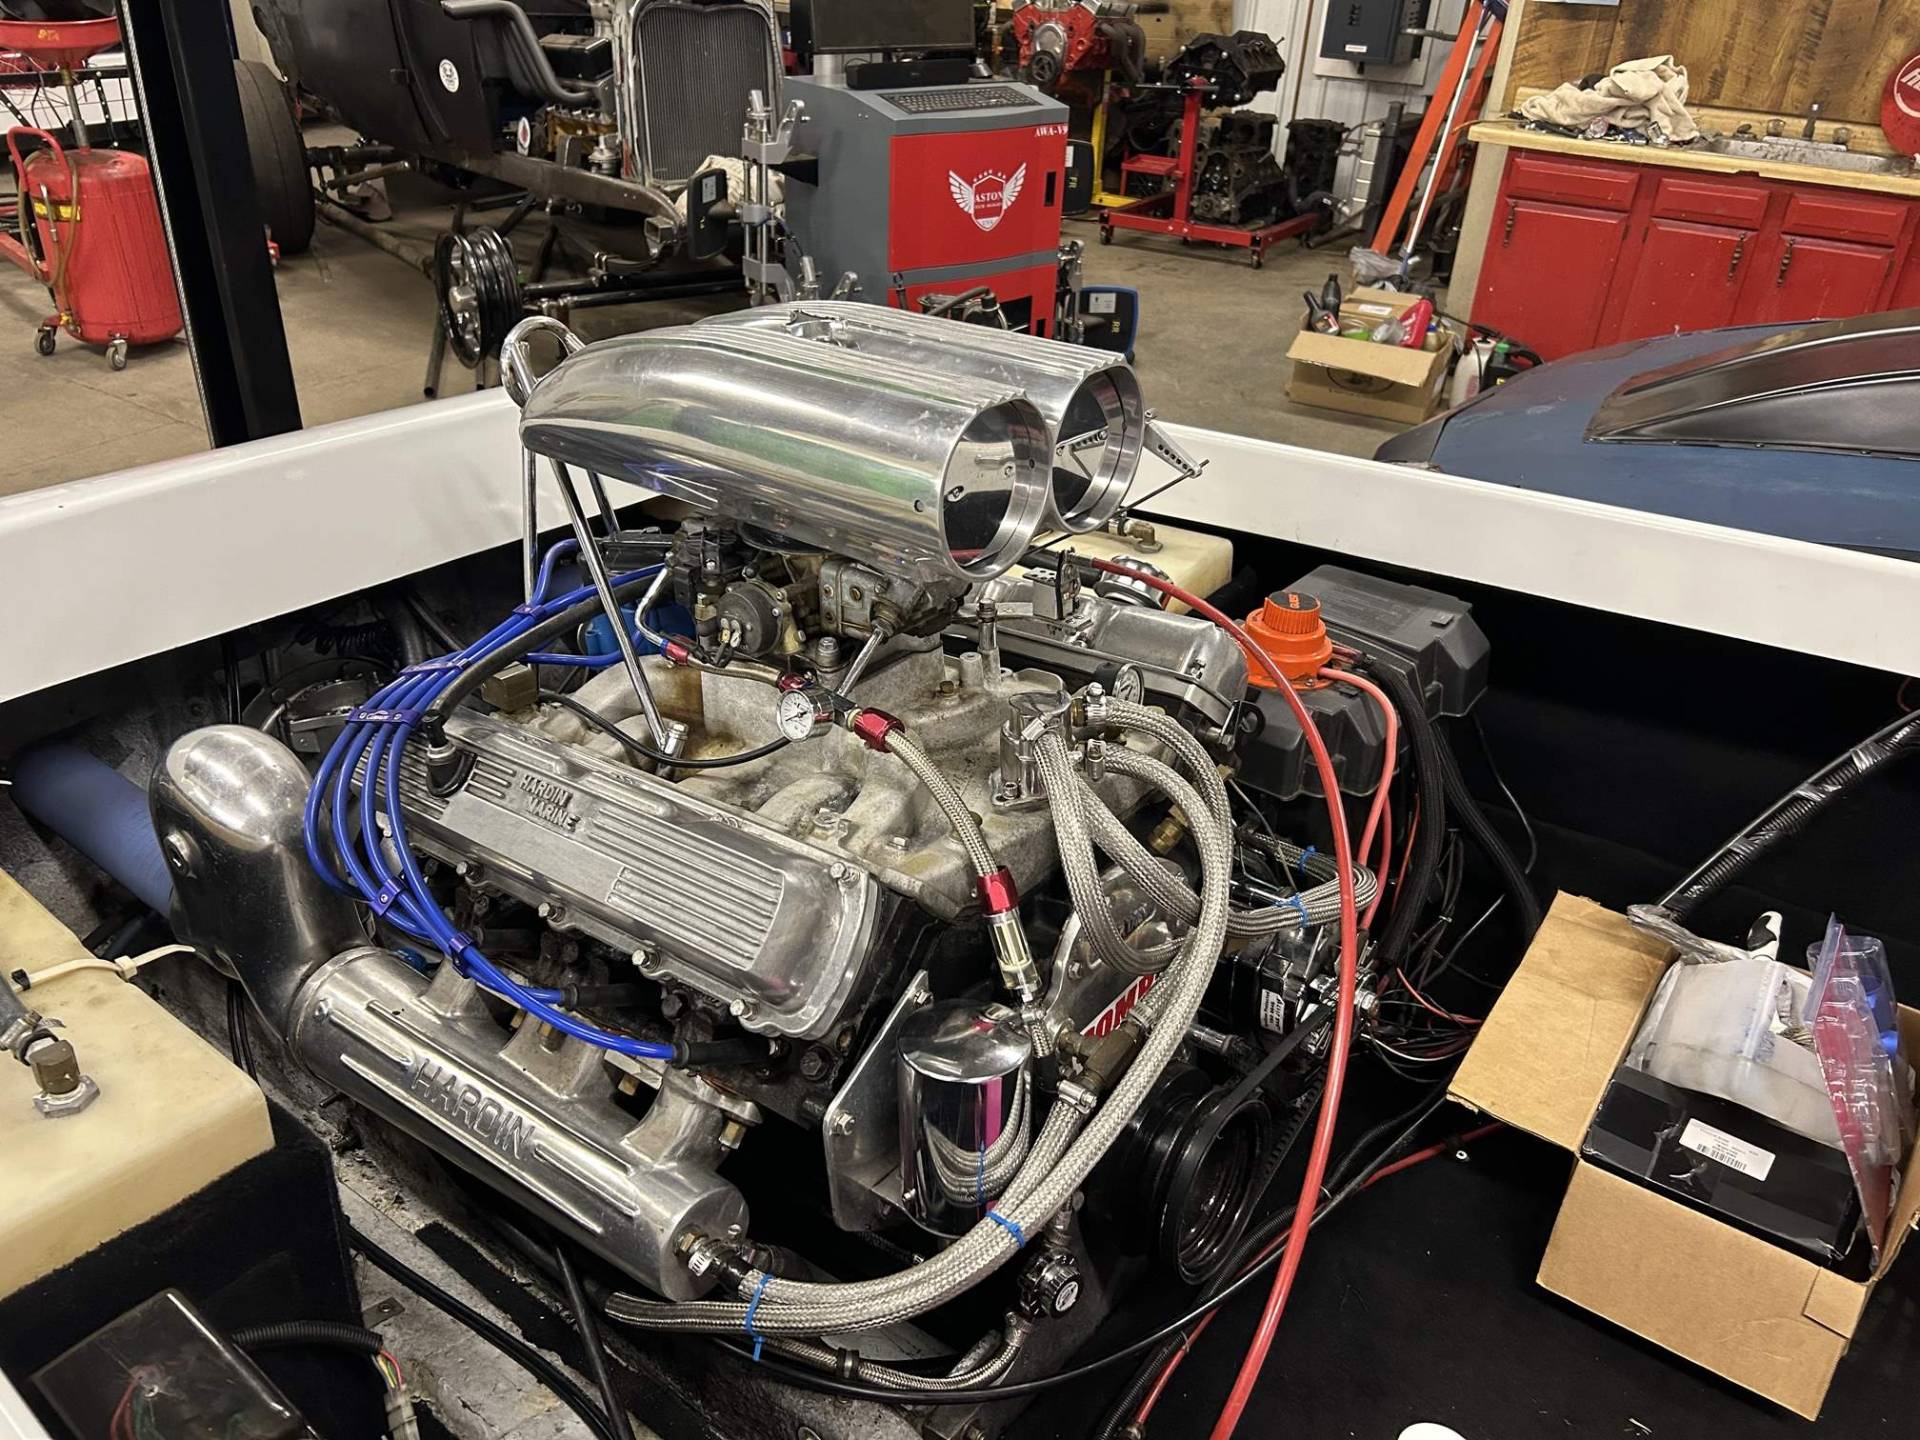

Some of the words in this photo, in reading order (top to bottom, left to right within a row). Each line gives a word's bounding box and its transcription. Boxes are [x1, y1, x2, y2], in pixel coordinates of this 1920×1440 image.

[975, 191, 1003, 202] ASTON
[520, 774, 573, 808] HARDIN
[527, 796, 581, 833] MARINE
[411, 1058, 535, 1160] HARDIN
